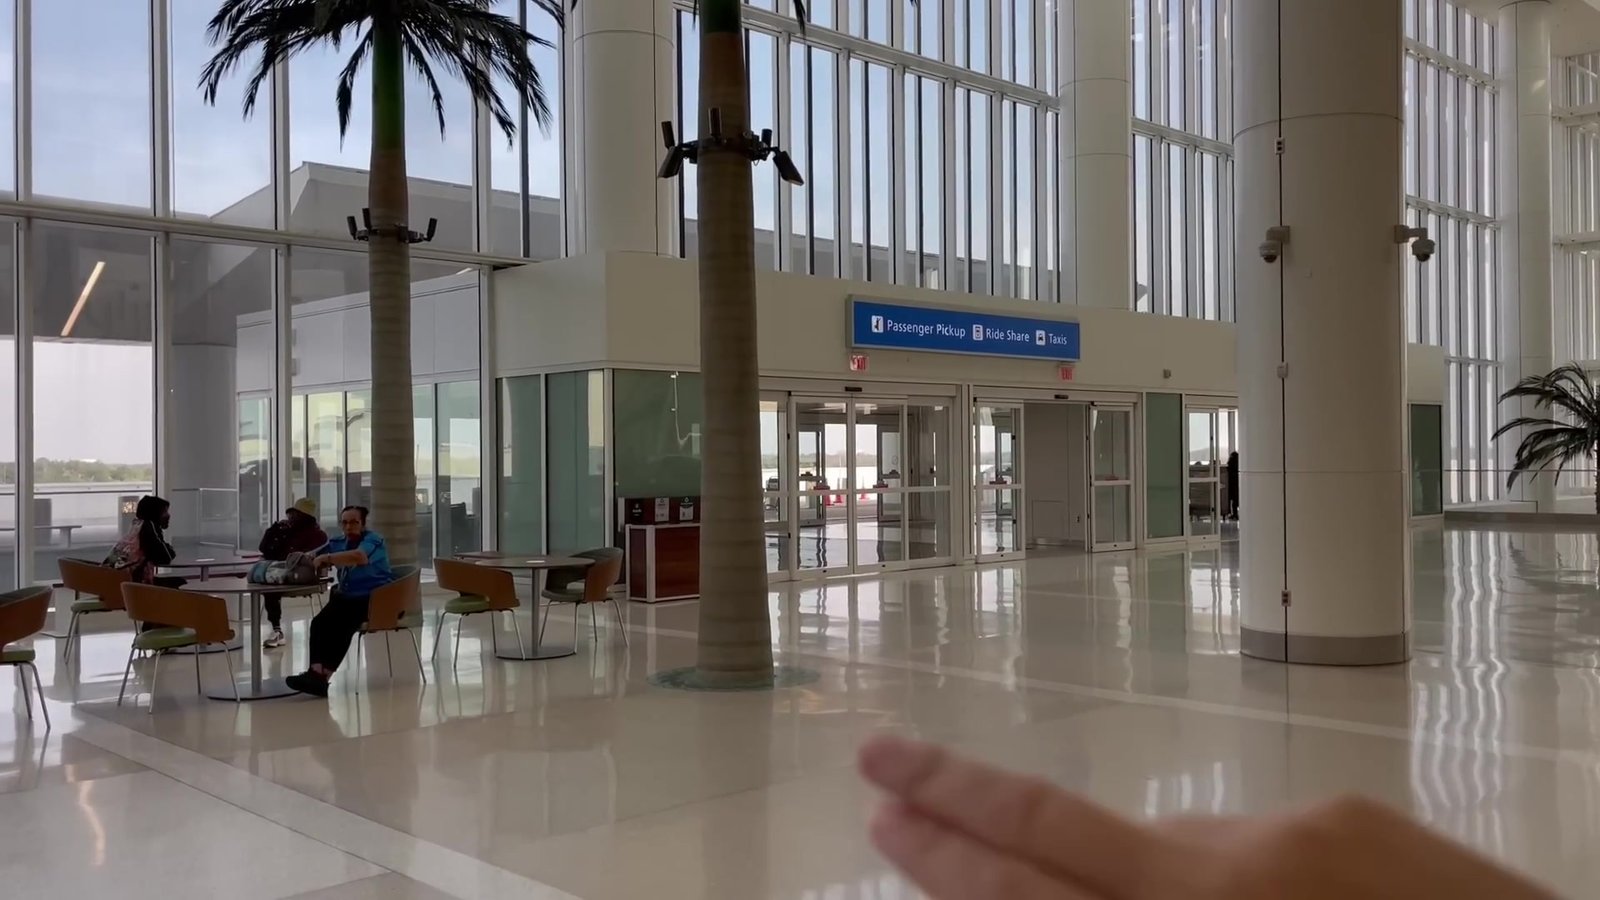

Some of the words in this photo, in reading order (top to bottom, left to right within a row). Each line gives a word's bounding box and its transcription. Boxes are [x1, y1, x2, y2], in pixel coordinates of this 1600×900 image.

[887, 319, 934, 337] Passenger
[936, 323, 966, 339] Pickup
[986, 328, 1005, 340] Ride
[1006, 329, 1030, 342] Share
[1048, 333, 1067, 345] Taxis
